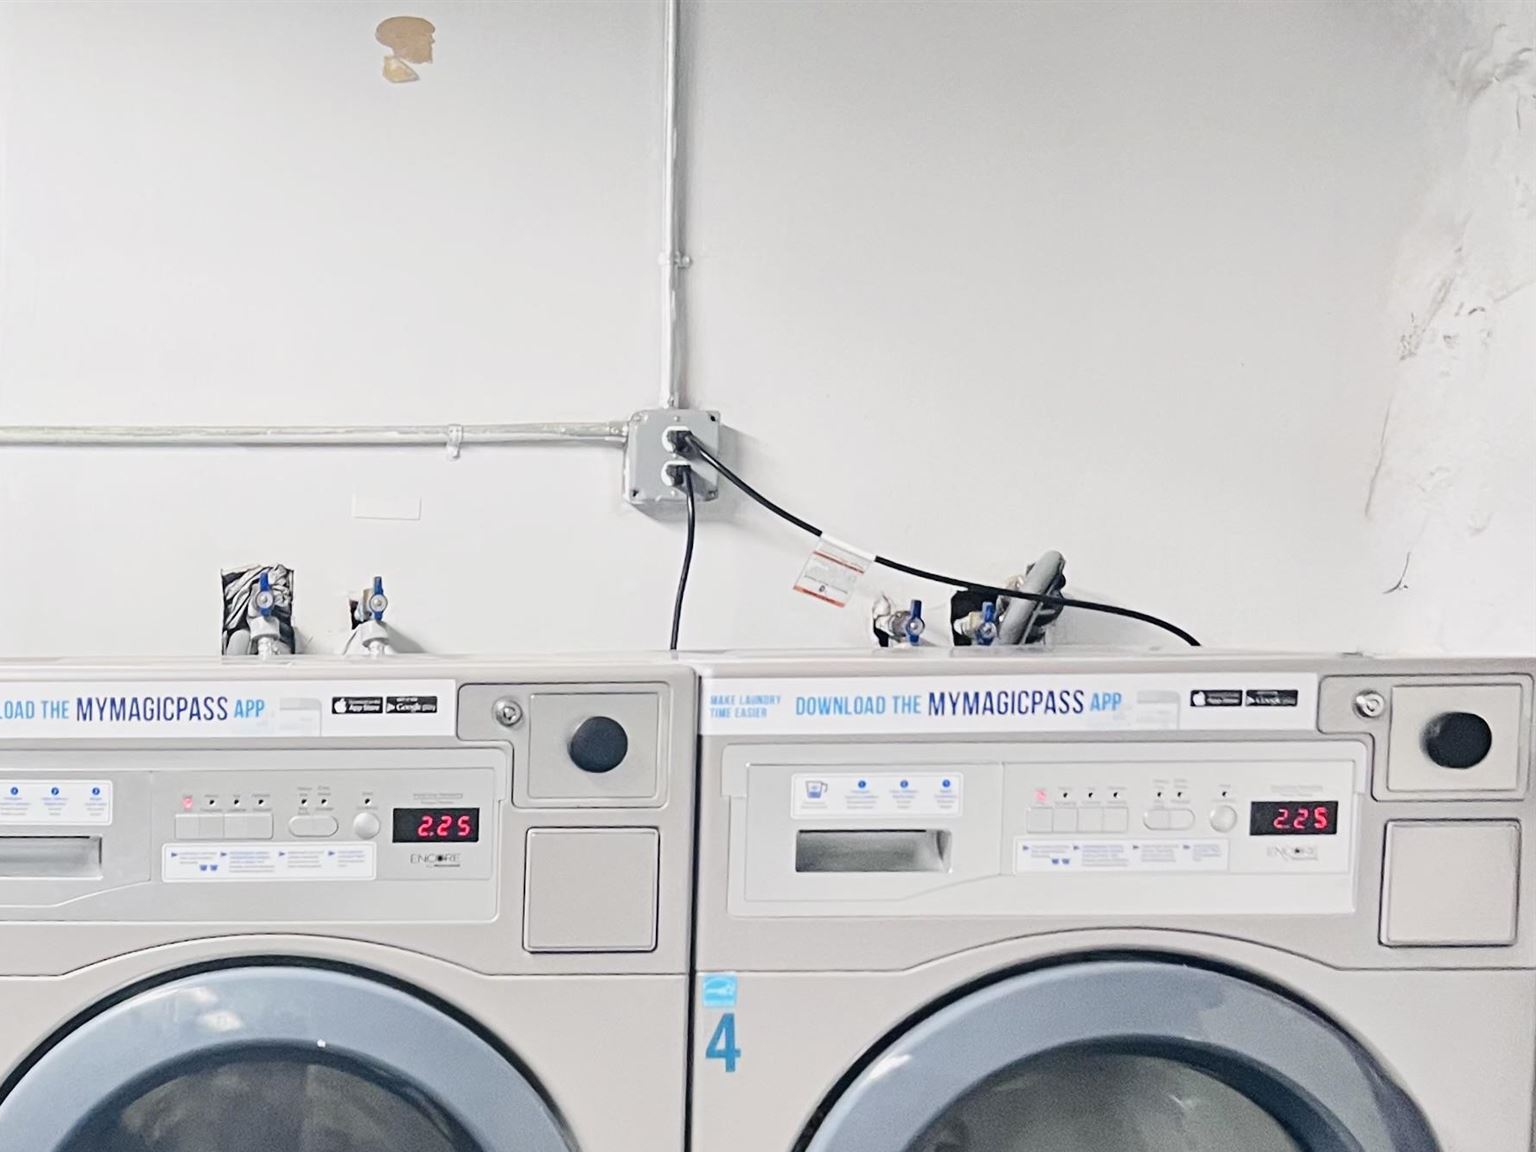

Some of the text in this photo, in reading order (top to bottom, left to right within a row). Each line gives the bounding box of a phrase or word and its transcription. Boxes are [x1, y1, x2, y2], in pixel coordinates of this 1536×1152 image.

[41, 700, 70, 719] THE
[76, 696, 228, 722] MYMAGICPASS
[234, 699, 265, 718] APP
[710, 695, 782, 705] MAKE LAUNDRY
[710, 707, 767, 718] TIME EASIER
[795, 690, 1122, 716] DOWNLOAD THE MYMAGICPASS APP
[706, 1013, 741, 1072] 4
